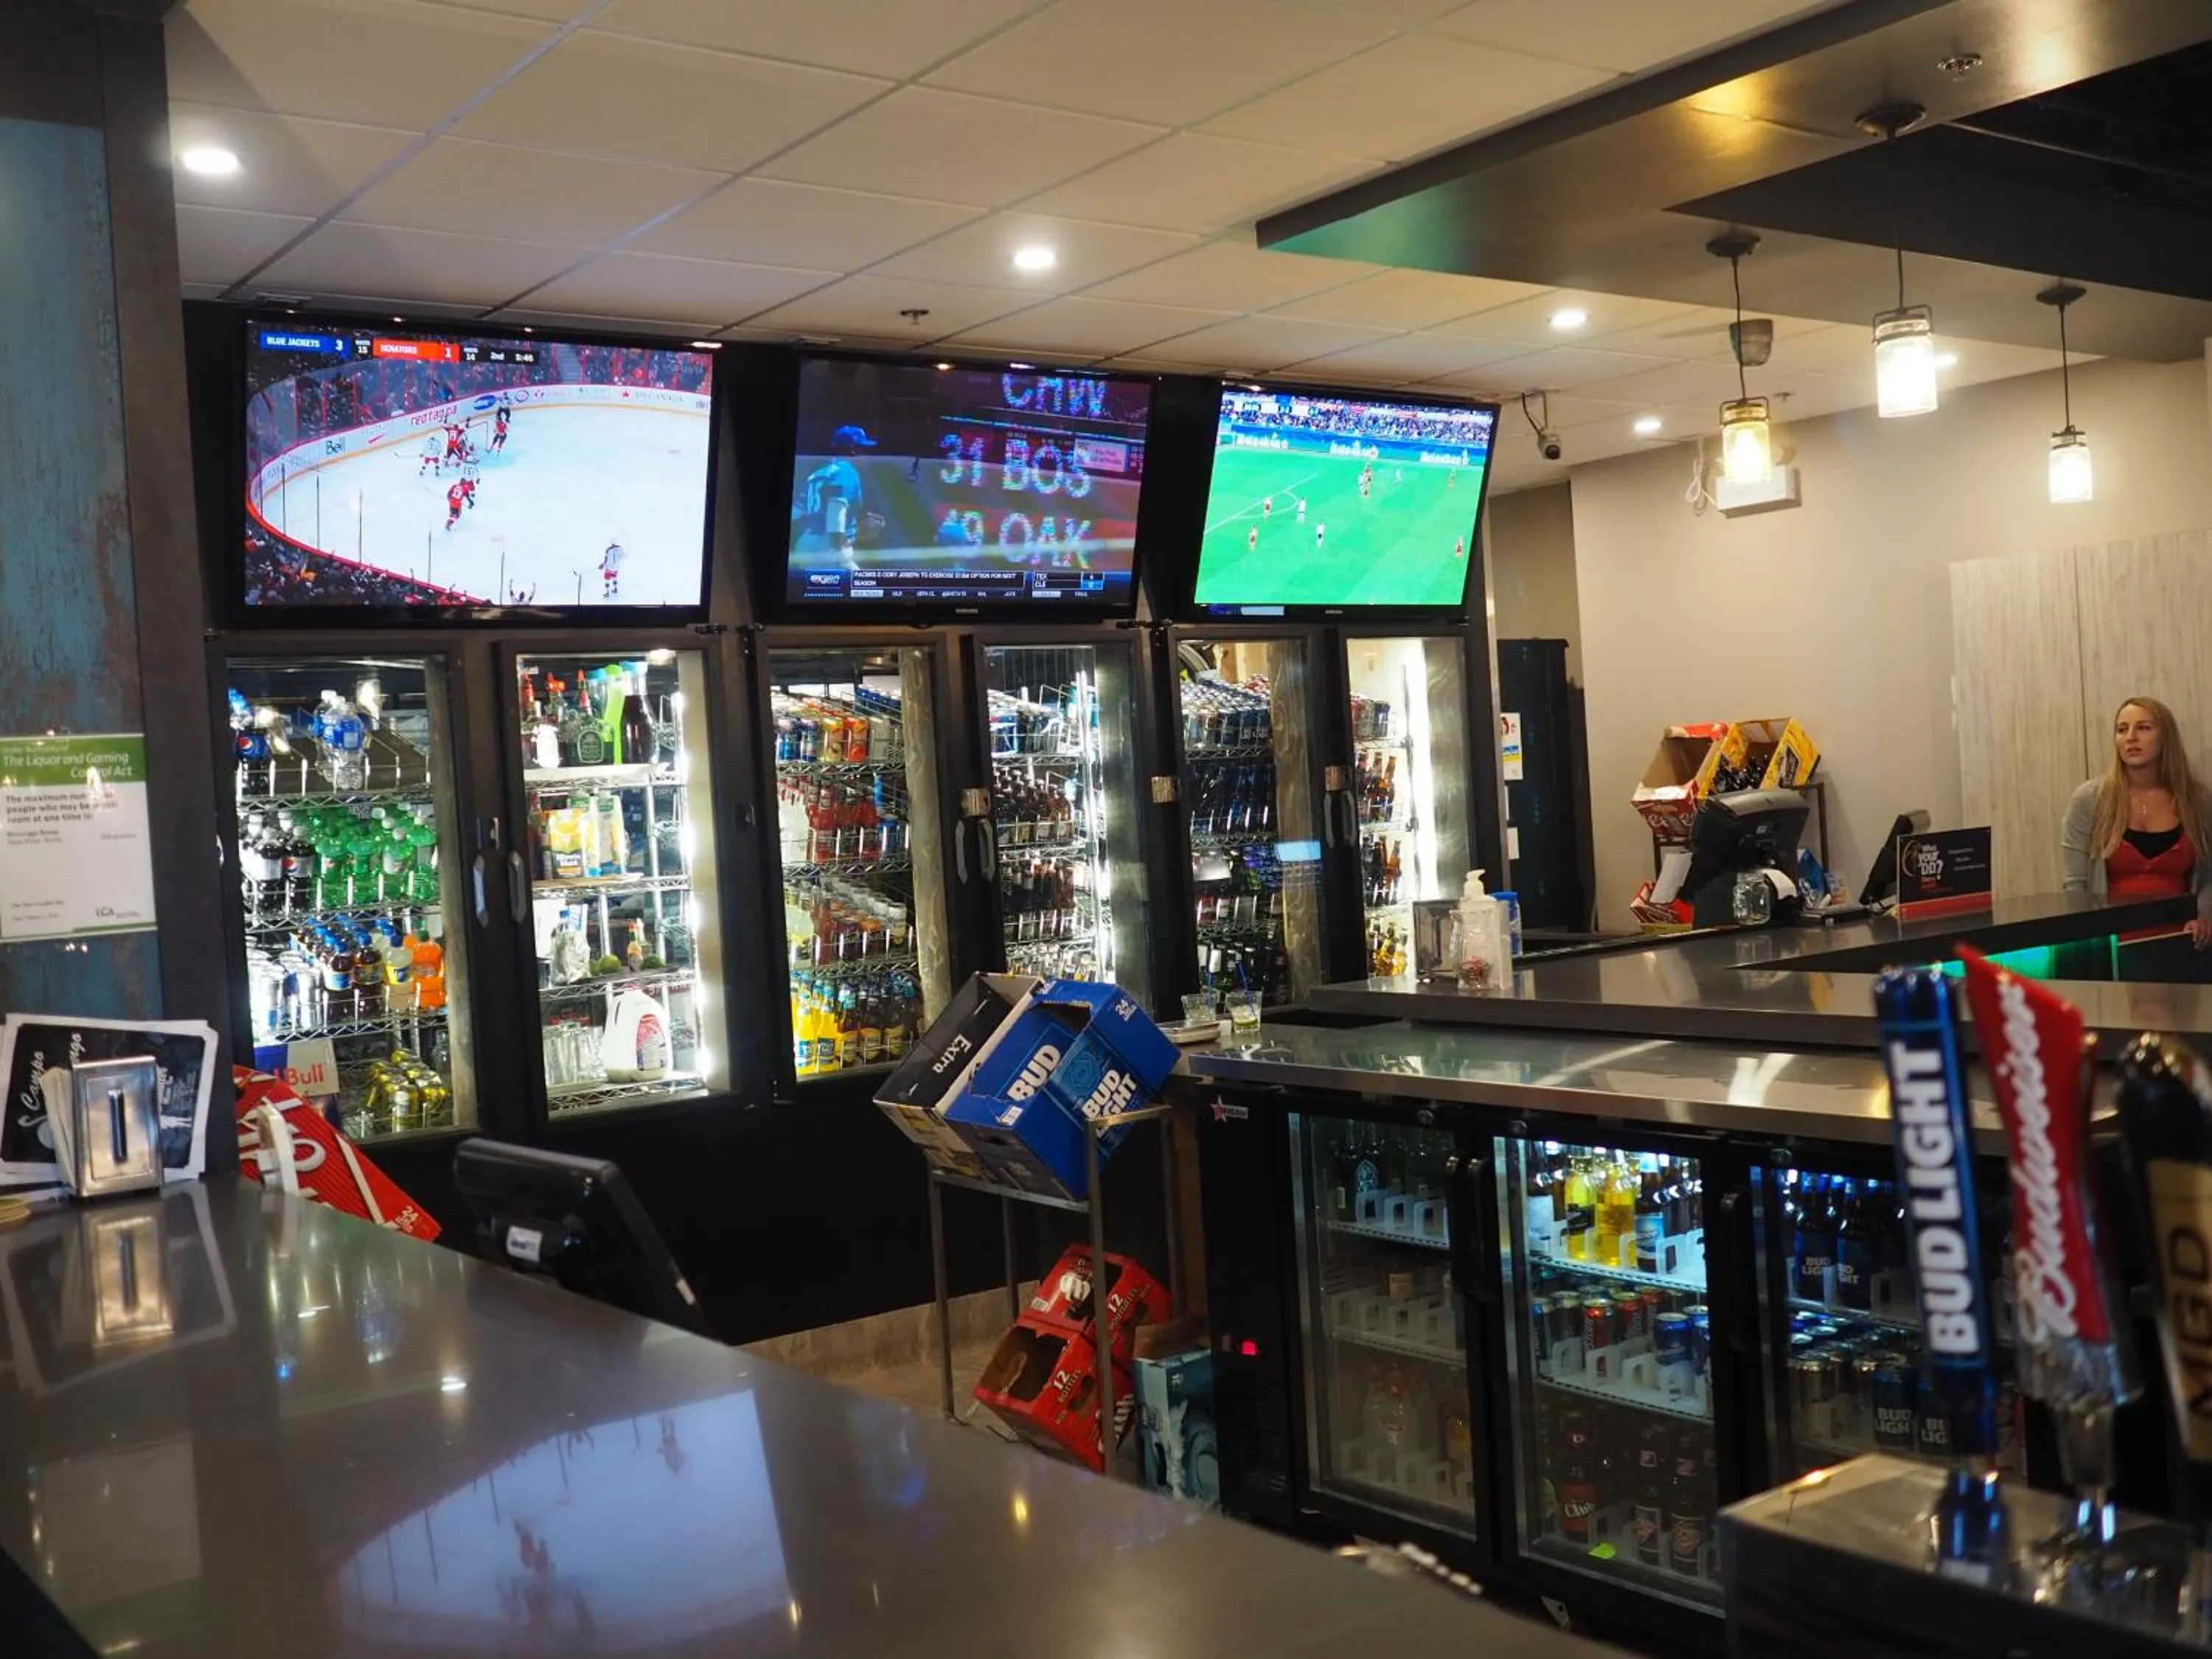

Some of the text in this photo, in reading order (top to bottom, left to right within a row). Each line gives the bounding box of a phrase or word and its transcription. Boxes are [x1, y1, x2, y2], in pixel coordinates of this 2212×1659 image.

[267, 336, 320, 348] BLUE JACKETS
[335, 339, 343, 351] 3
[380, 344, 417, 354] SENATORS
[445, 347, 451, 358] 1
[490, 352, 504, 361] 2nd
[325, 439, 346, 454] Bell
[940, 434, 985, 487] 31
[1003, 439, 1091, 498] BOS
[999, 512, 1091, 568] OAK
[4, 752, 129, 768] The Liquor and Gaming
[70, 765, 133, 779] Corol Act
[6, 795, 21, 804] The
[24, 794, 68, 803] maximum
[7, 804, 38, 814] people
[38, 803, 58, 812] who
[59, 803, 77, 813] may
[79, 801, 90, 810] be
[7, 815, 31, 824] room
[33, 814, 42, 822] at
[44, 814, 60, 822] one
[61, 813, 81, 821] time
[931, 1034, 973, 1074] Extra
[283, 1062, 324, 1086] Bull
[1006, 1044, 1062, 1103] BUD
[1081, 1069, 1121, 1119] BUD
[1096, 1073, 1139, 1138] LGHT
[1997, 980, 2078, 1345] Budweiser
[1891, 1040, 1979, 1355] BUD LIGHT
[1805, 1256, 1832, 1266] BUD
[1108, 1293, 1123, 1313] 12
[1054, 1369, 1071, 1391] 12
[1877, 1407, 1912, 1421] BUD
